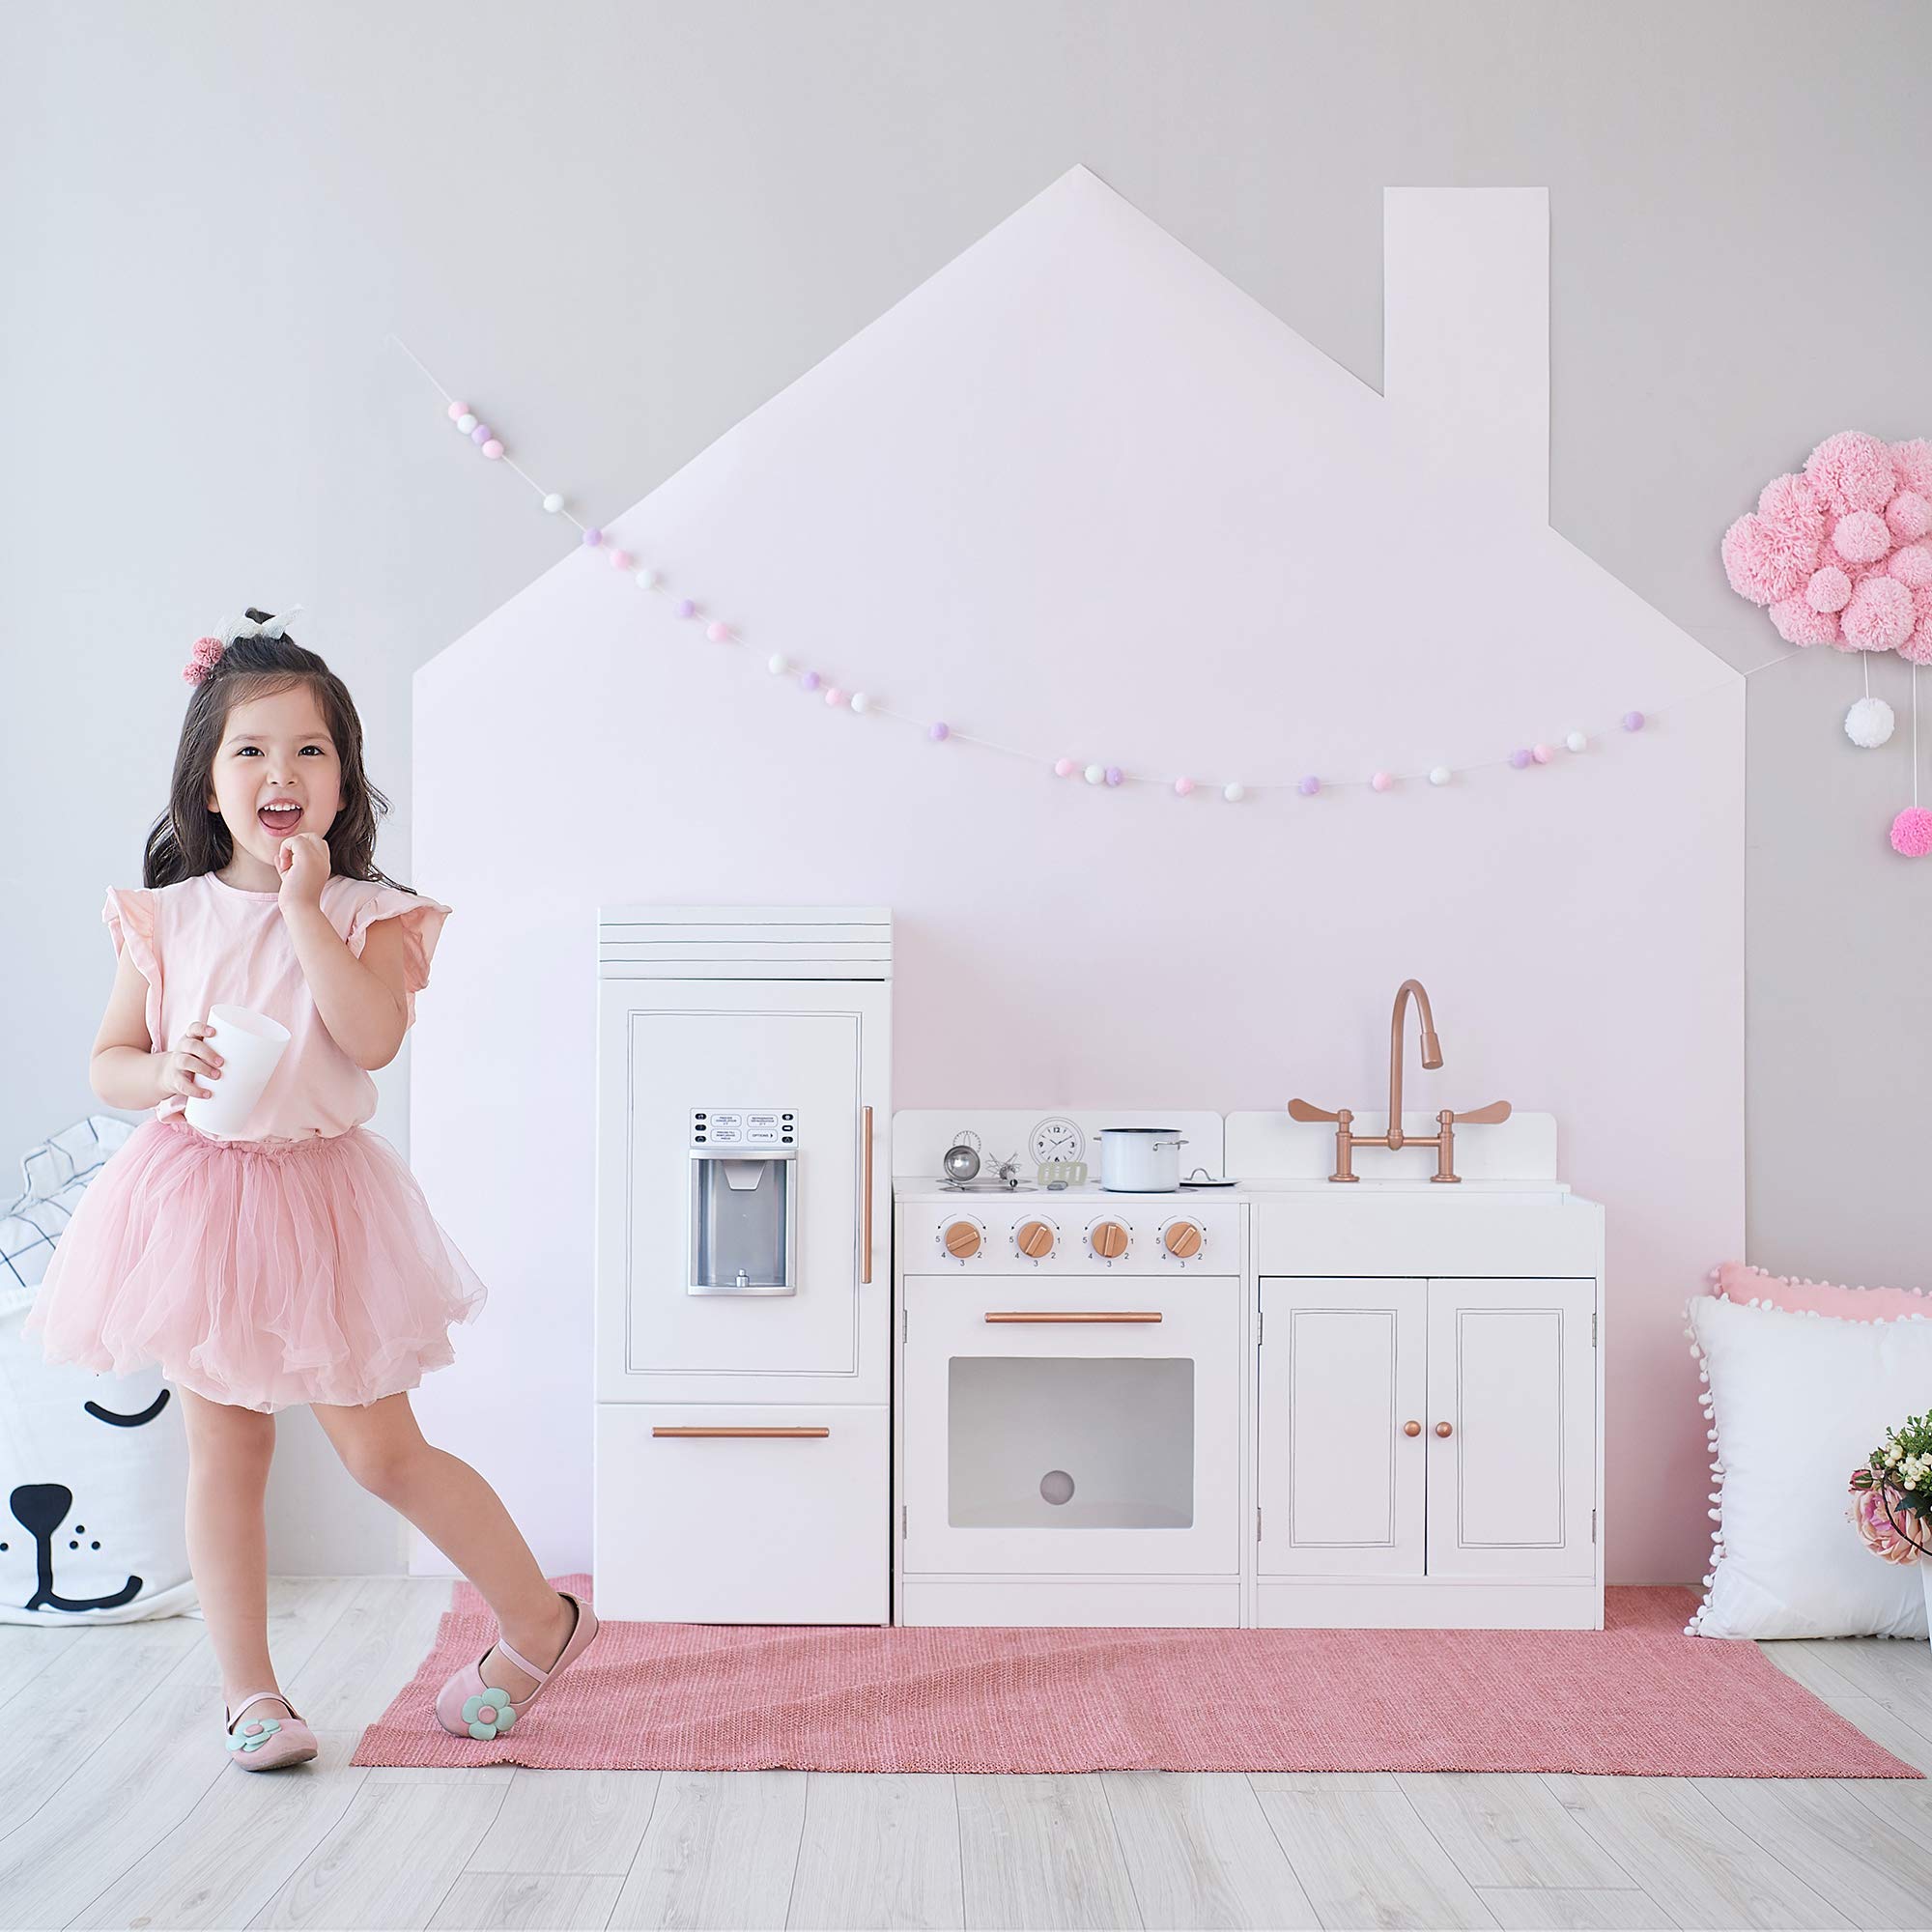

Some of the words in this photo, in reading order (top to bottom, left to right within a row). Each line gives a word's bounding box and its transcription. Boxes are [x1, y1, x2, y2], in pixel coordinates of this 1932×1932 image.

[935, 1235, 941, 1243] 5
[1009, 1236, 1014, 1244] 5
[1082, 1236, 1088, 1244] 5
[1155, 1236, 1161, 1245] 5
[1014, 1251, 1020, 1260] 4
[1050, 1251, 1057, 1260] 2
[1197, 1252, 1204, 1261] 2
[959, 1259, 966, 1267] 3
[1033, 1259, 1038, 1267] 3
[1106, 1260, 1113, 1268] 3
